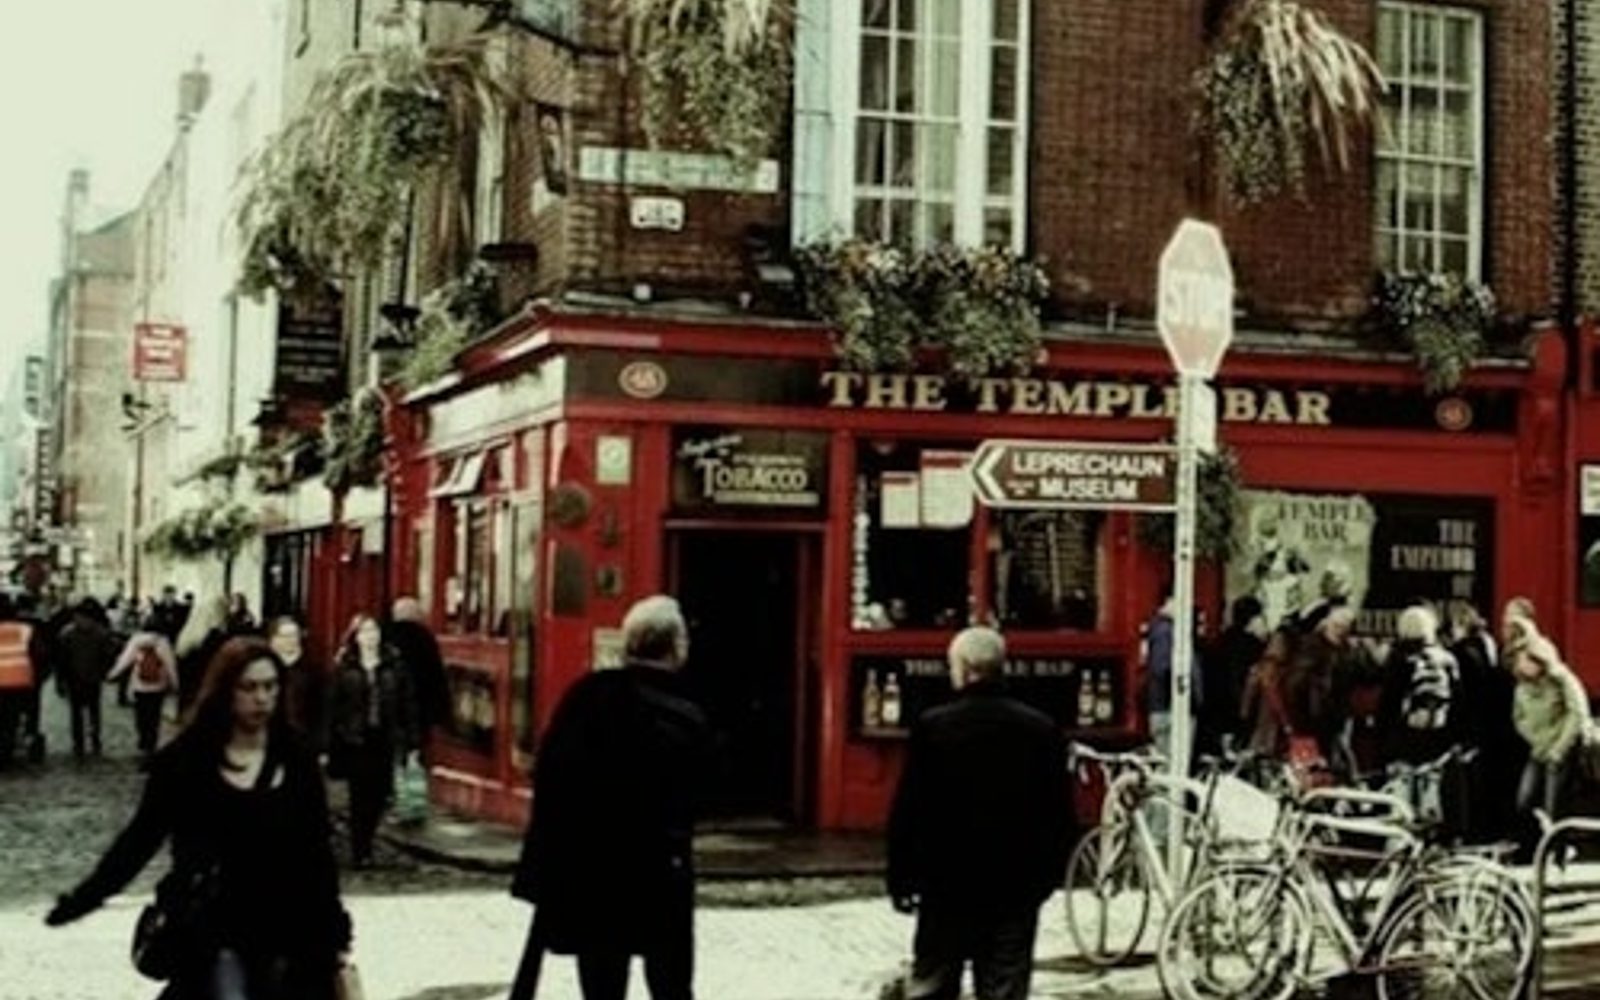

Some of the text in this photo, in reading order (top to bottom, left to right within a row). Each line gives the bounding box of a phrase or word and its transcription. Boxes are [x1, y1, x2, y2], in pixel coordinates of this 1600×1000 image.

[820, 370, 948, 410] THE
[1222, 387, 1331, 425] BAR
[1013, 451, 1166, 476] LEPRECHAUN
[1038, 477, 1139, 499] MUSEUM
[1277, 502, 1368, 521] TEMPLE
[1303, 522, 1348, 543] BAR
[1438, 519, 1476, 546] THE
